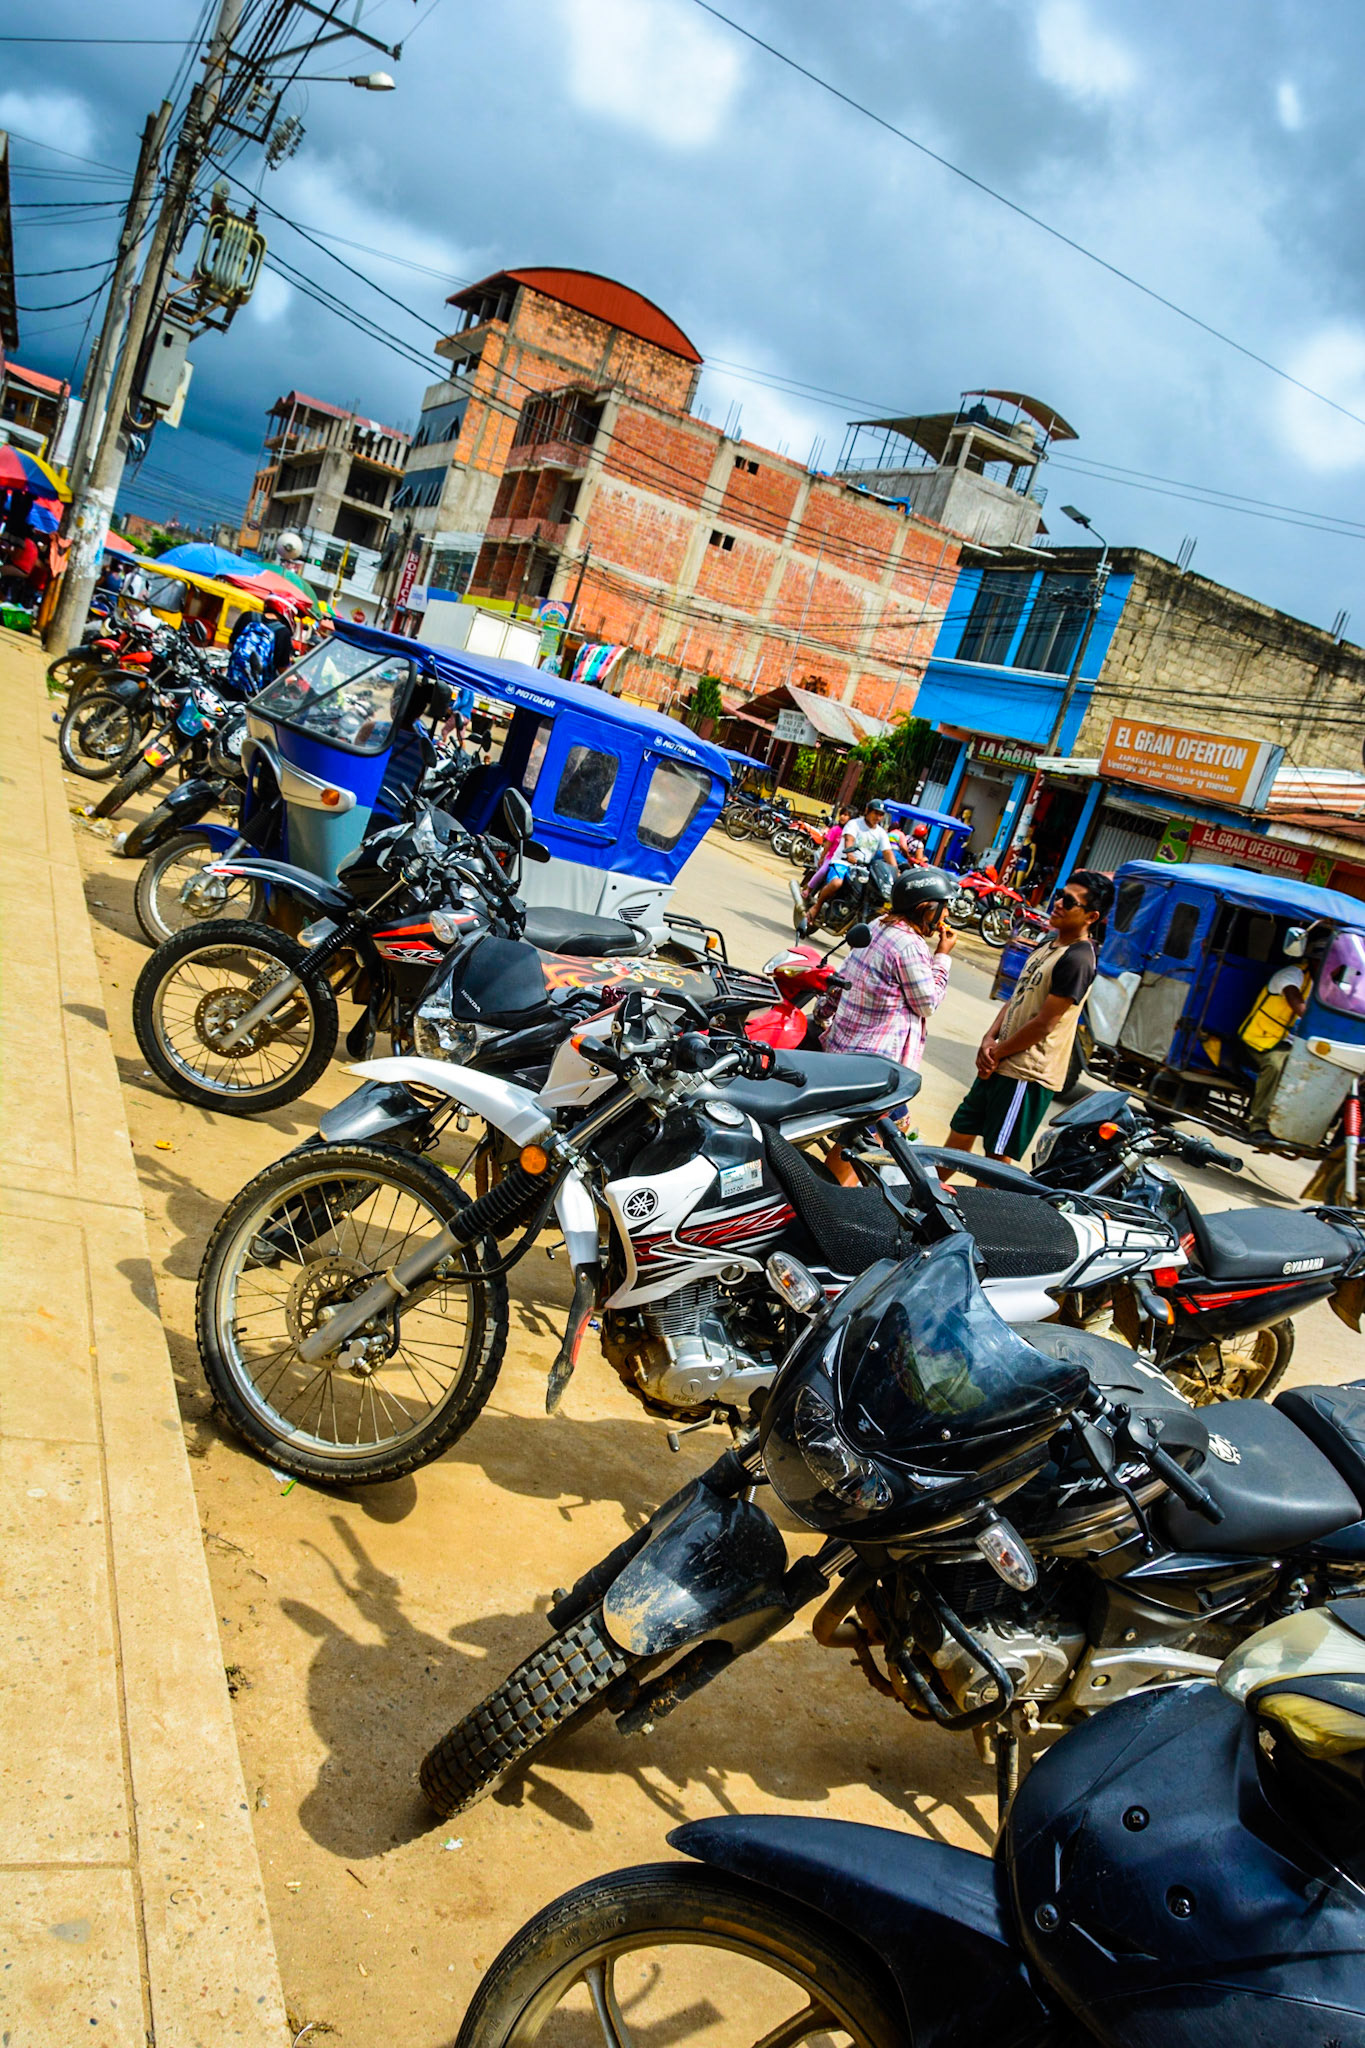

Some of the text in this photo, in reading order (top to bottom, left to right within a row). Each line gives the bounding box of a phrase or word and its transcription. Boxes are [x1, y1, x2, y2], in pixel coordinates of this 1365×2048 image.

[398, 552, 419, 606] BOTICA
[515, 689, 556, 709] MOTOKAR
[662, 740, 697, 758] MOTOKAR
[979, 741, 996, 758] LA
[1115, 727, 1248, 770] EL GRAN OFERTON
[1107, 759, 1137, 772] Ventas
[1138, 766, 1148, 775] al
[1147, 770, 1165, 778] por
[1166, 773, 1195, 785] mayor
[1197, 780, 1204, 789] y
[1202, 828, 1301, 866] EL GRAN OFERTON
[460, 989, 481, 1013] HONDA
[1291, 1257, 1324, 1274] YAMAHA
